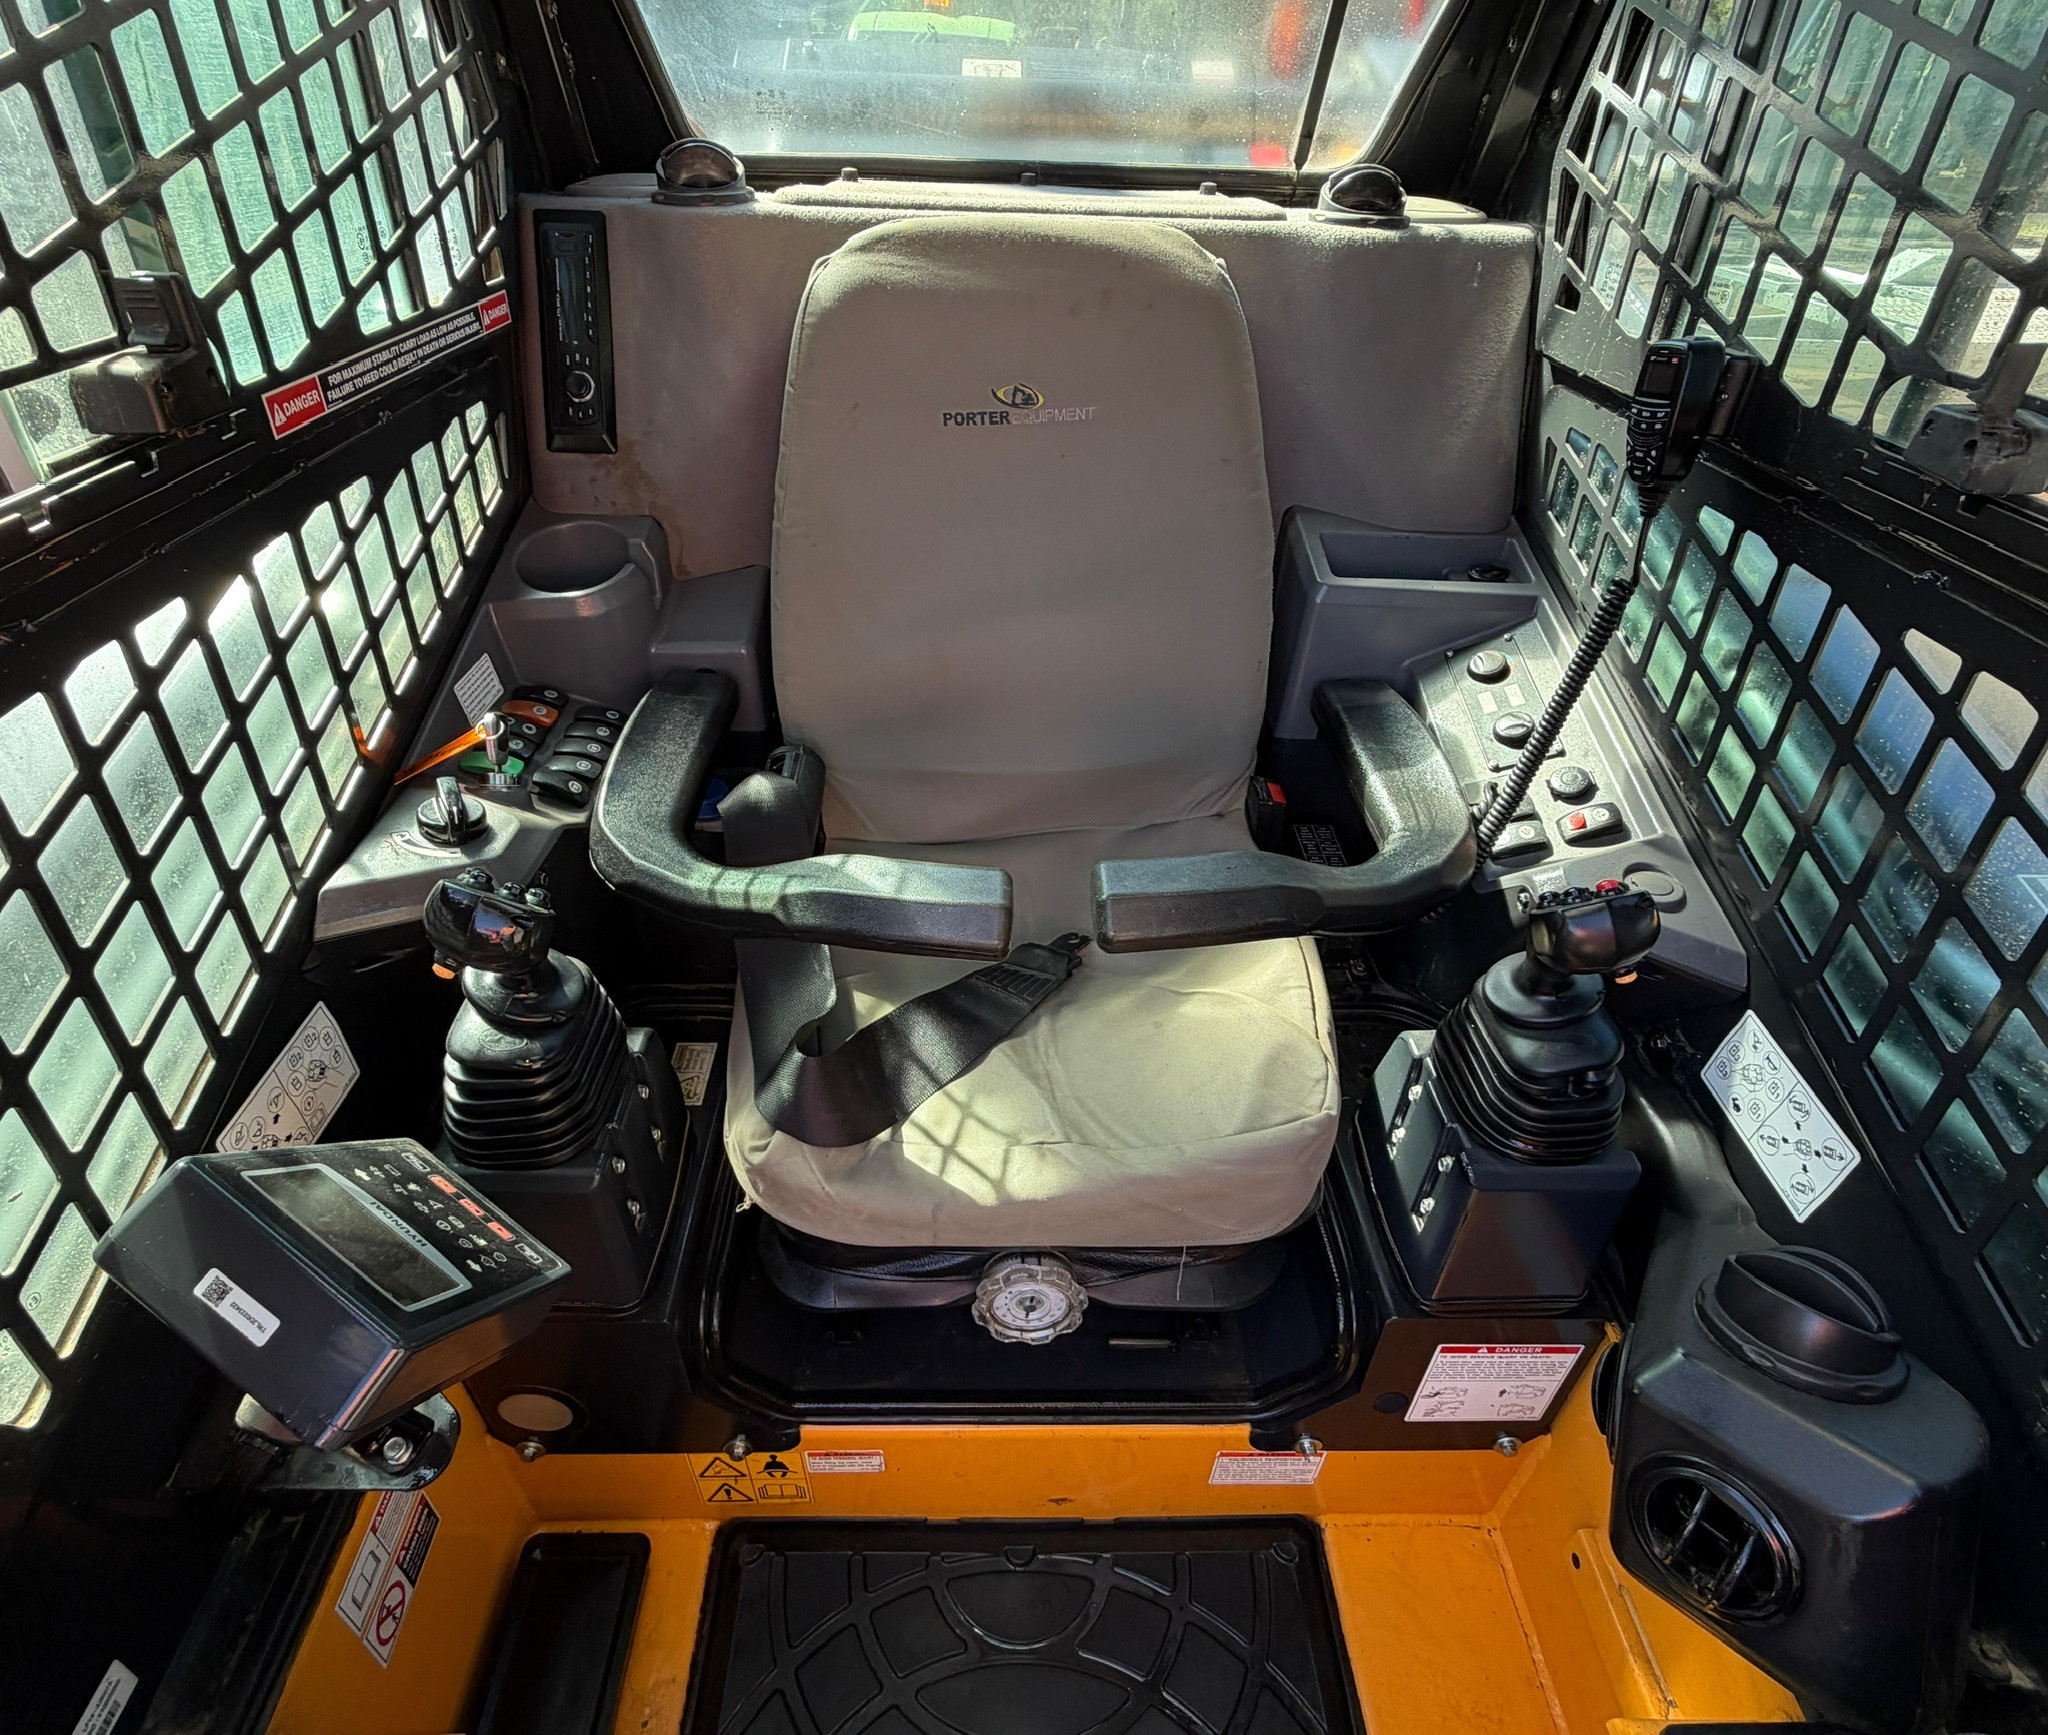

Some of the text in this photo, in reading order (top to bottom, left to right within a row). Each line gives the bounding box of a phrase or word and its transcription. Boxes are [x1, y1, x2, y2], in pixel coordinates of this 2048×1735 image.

[488, 303, 509, 321] DANGER
[327, 372, 343, 387] FOR
[341, 357, 373, 380] MAXIMUM
[371, 344, 400, 367] STABILITY
[399, 337, 418, 352] CARRY
[417, 331, 431, 346] LOAD
[430, 329, 437, 339] AS
[436, 324, 448, 337] LOW
[447, 321, 454, 331] AS
[327, 381, 356, 402] FAILURE
[354, 377, 364, 389] TO
[362, 370, 380, 386] HEED
[378, 360, 399, 378] COULD
[397, 350, 418, 368] RESULT
[417, 348, 424, 358] IN
[423, 341, 440, 356] DEATH
[438, 336, 447, 348] OR
[445, 328, 466, 345] SERIOUS
[283, 389, 320, 416] DANGER
[942, 406, 1096, 427] PORTER EQUIPMENT
[370, 1201, 428, 1247] HYUNDAI
[402, 1532, 419, 1569] CRUSH
[417, 1507, 430, 1533] RISK
[404, 1504, 425, 1547] DANGER
